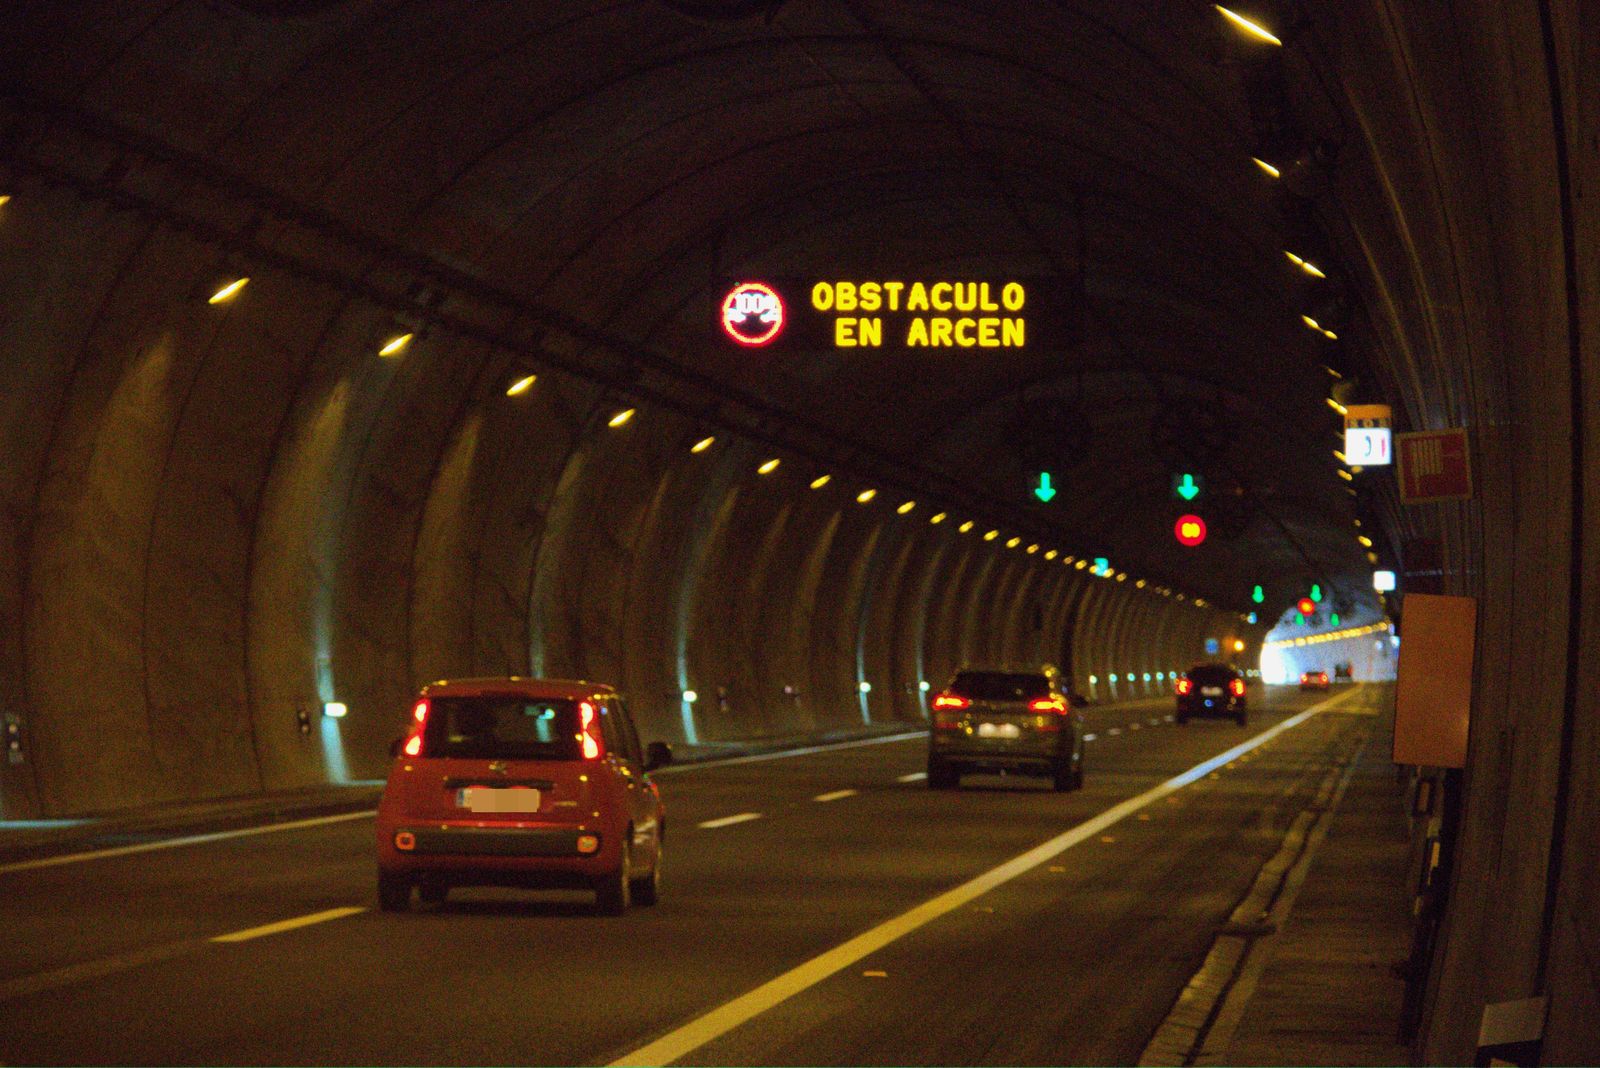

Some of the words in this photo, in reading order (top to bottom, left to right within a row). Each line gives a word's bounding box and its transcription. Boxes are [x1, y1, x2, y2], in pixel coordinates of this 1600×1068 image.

[811, 281, 1025, 312] OBSTACULO
[835, 317, 882, 348] EN
[906, 317, 1025, 348] ARCEN
